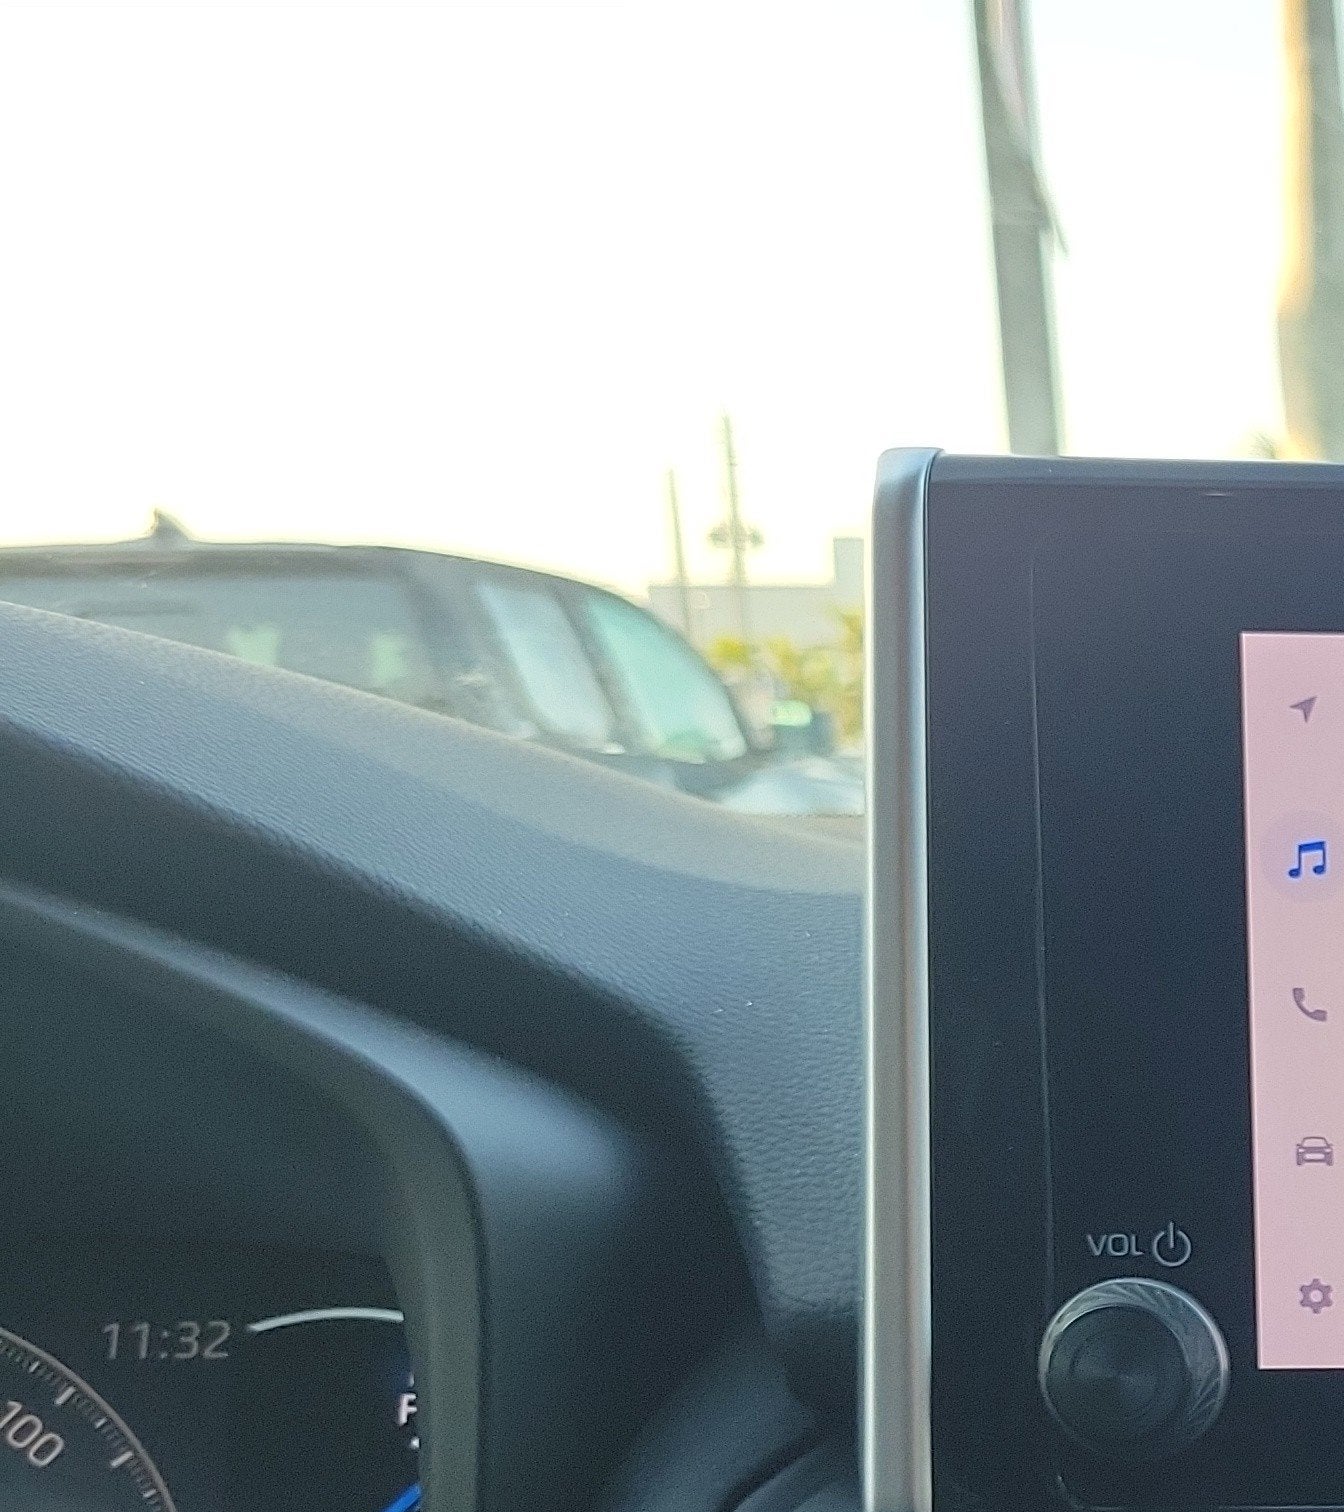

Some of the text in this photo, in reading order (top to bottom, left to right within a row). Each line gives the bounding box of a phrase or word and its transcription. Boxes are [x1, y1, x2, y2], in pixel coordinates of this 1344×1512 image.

[1086, 1233, 1145, 1257] VOL
[102, 1320, 231, 1361] 11:32
[0, 1400, 65, 1468] 100
